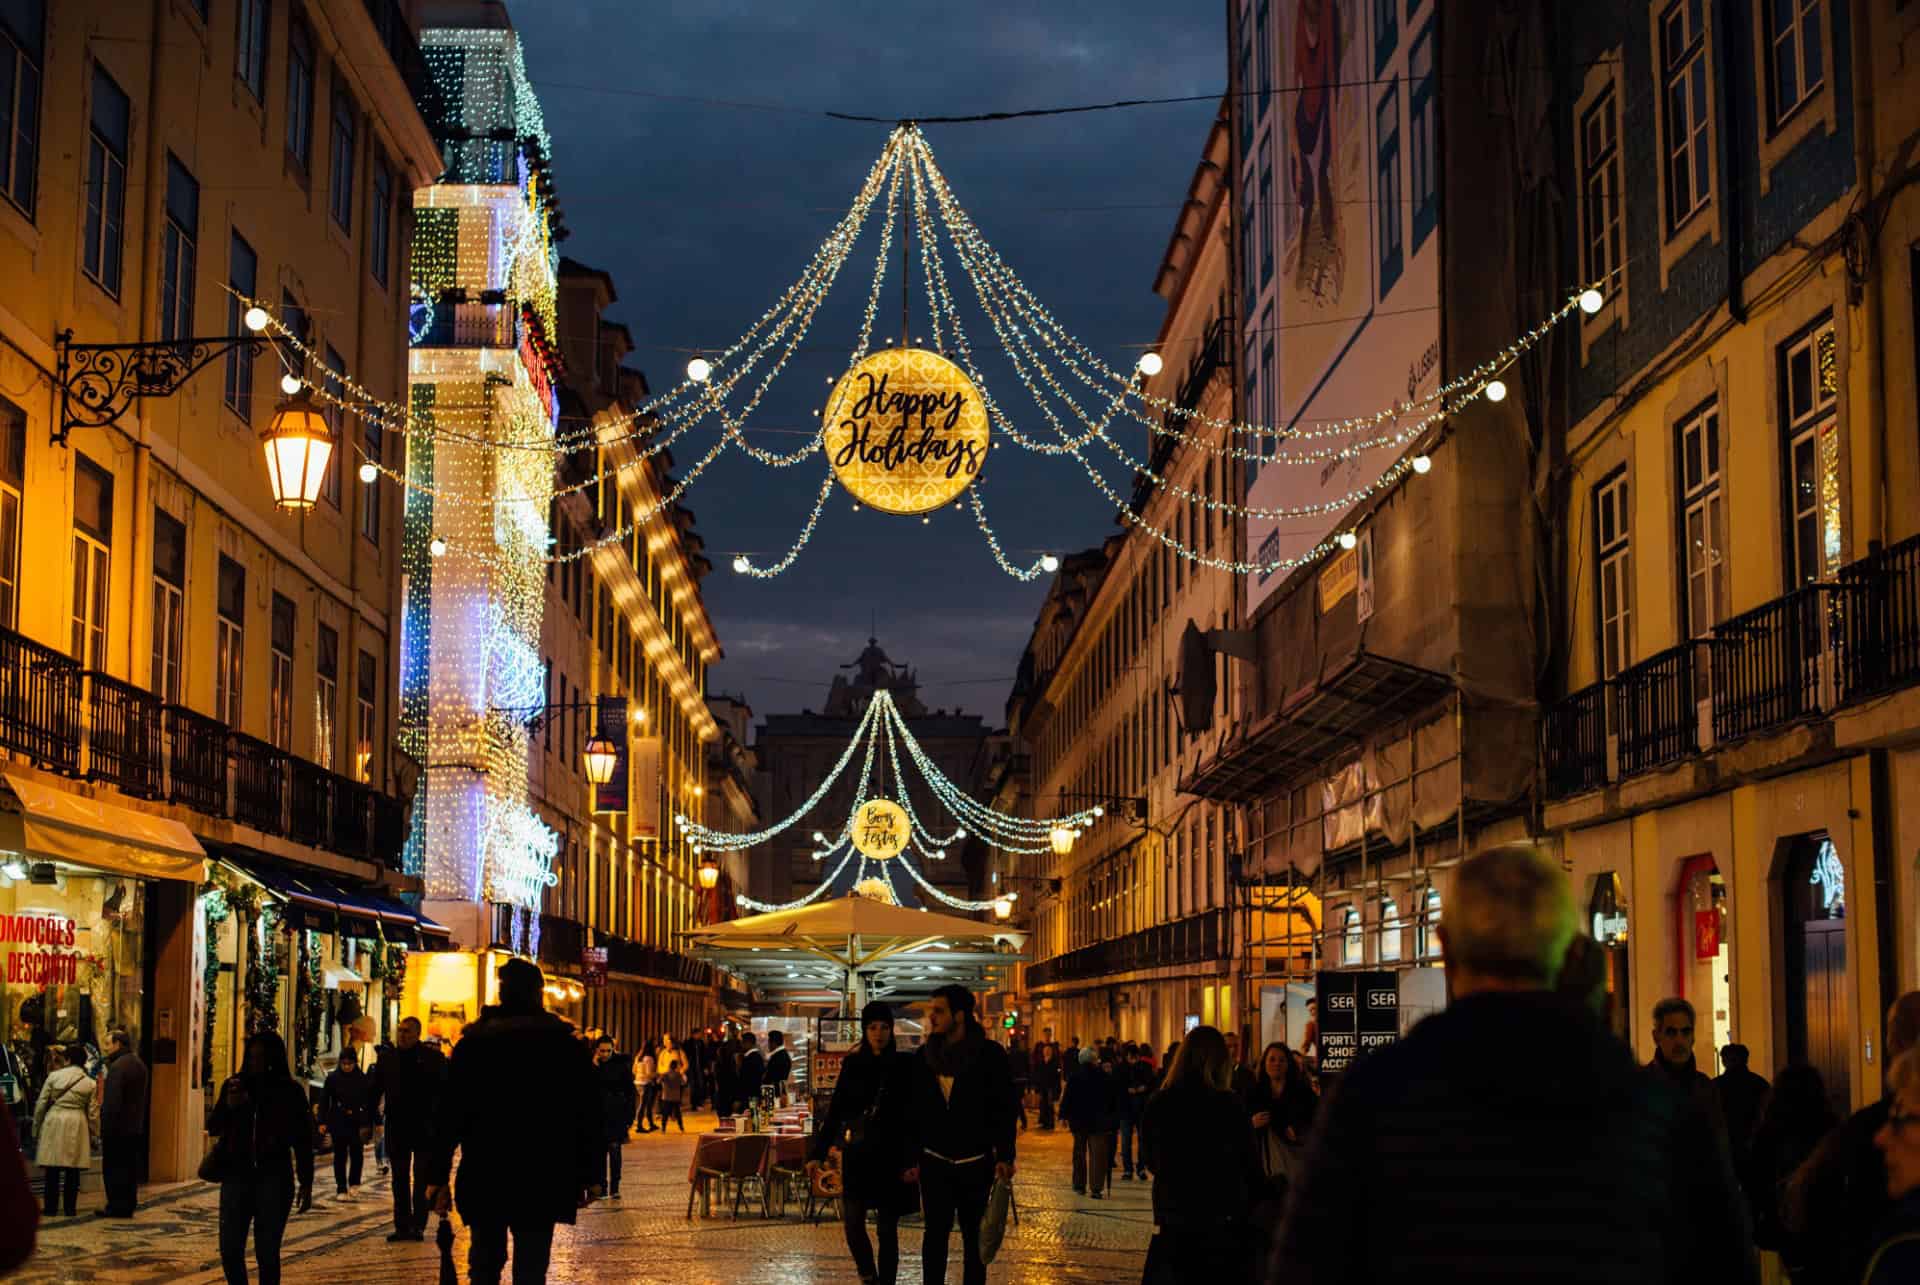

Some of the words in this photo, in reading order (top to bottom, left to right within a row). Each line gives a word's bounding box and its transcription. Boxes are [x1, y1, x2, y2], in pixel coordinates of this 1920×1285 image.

[852, 372, 968, 431] Happy
[835, 420, 985, 479] Holidays
[7, 951, 77, 984] DESCONTO
[1331, 996, 1354, 1009] SEA
[1371, 993, 1396, 1006] SEA
[1361, 1035, 1395, 1047] PORT
